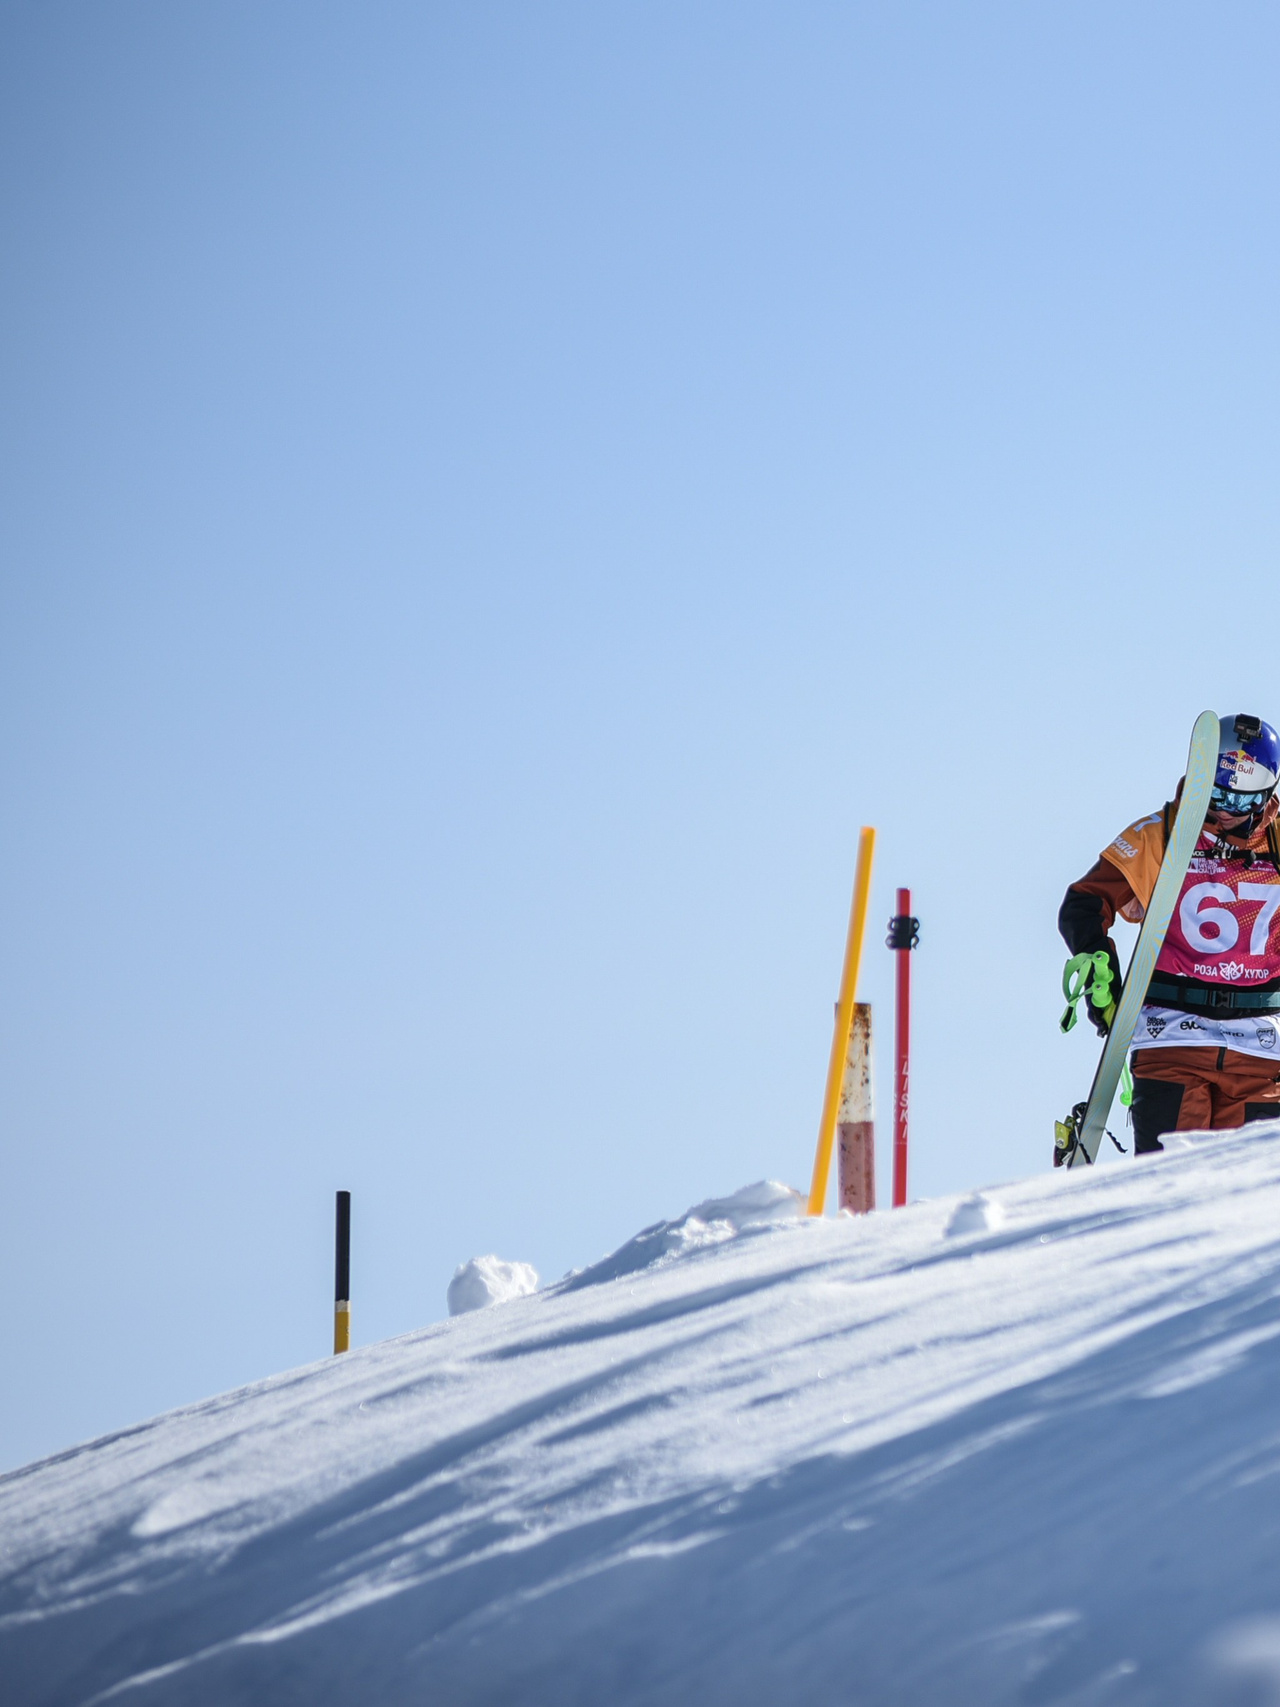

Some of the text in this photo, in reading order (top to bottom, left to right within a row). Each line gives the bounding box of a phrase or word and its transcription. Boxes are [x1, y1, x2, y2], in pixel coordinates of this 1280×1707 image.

[1221, 759, 1254, 775] Red Bull
[1194, 963, 1269, 979] РОЗА ХУТОР
[900, 1060, 909, 1139] LISKI
